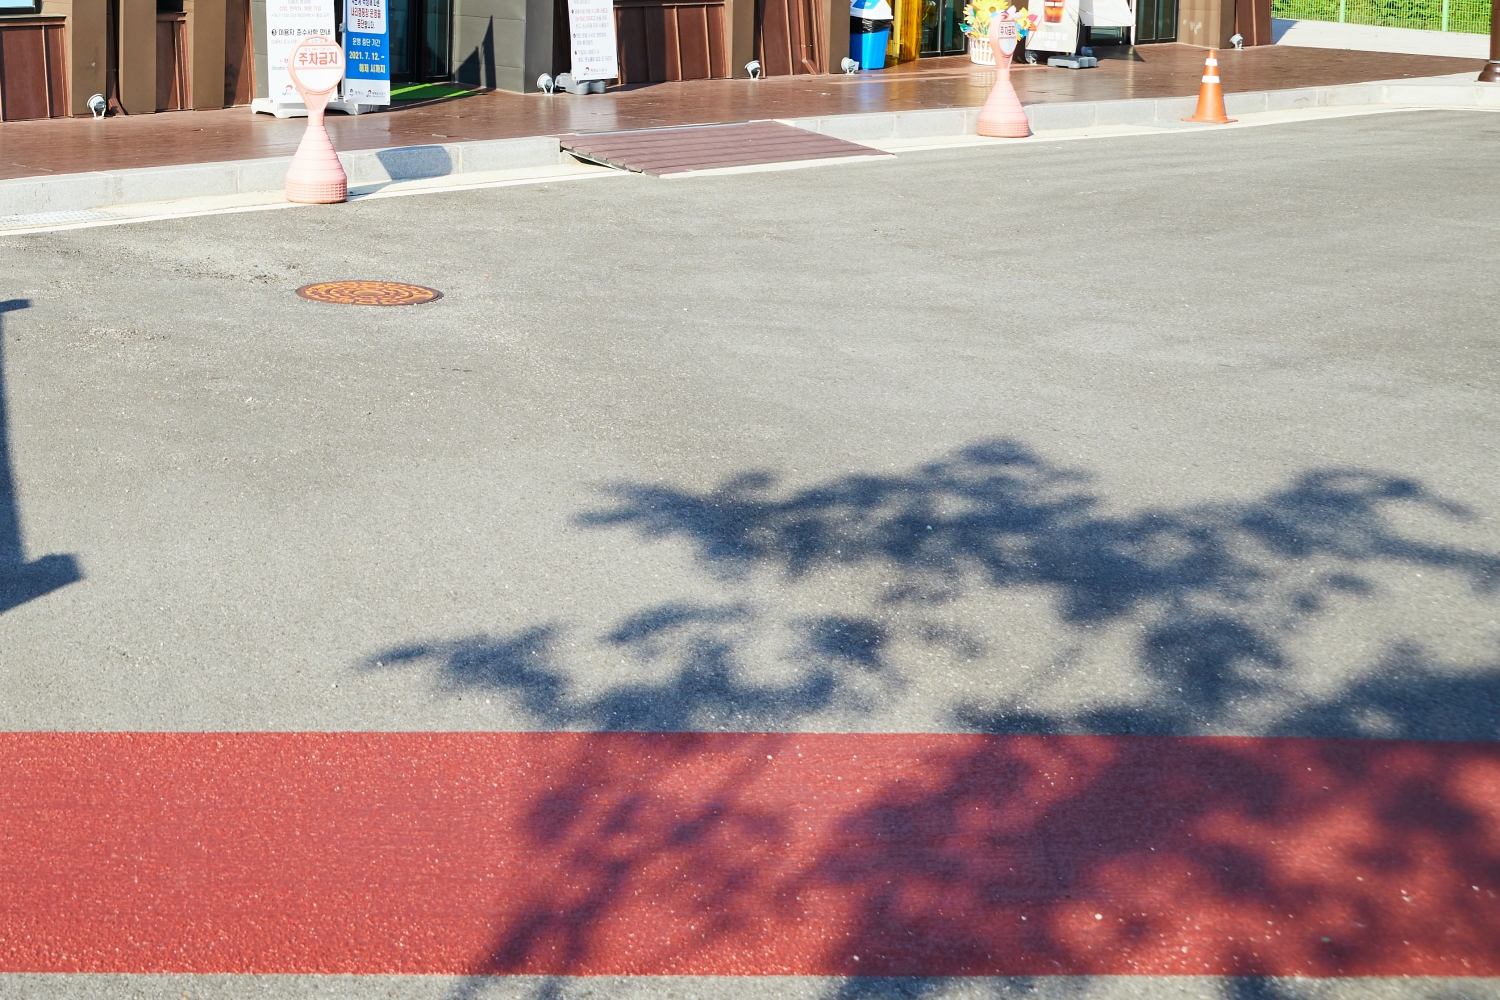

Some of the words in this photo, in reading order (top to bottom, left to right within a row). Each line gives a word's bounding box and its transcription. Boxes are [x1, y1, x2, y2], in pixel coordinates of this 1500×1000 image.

[352, 38, 361, 46] 운영
[298, 52, 338, 65] 주차금지
[349, 51, 364, 60] 2021.
